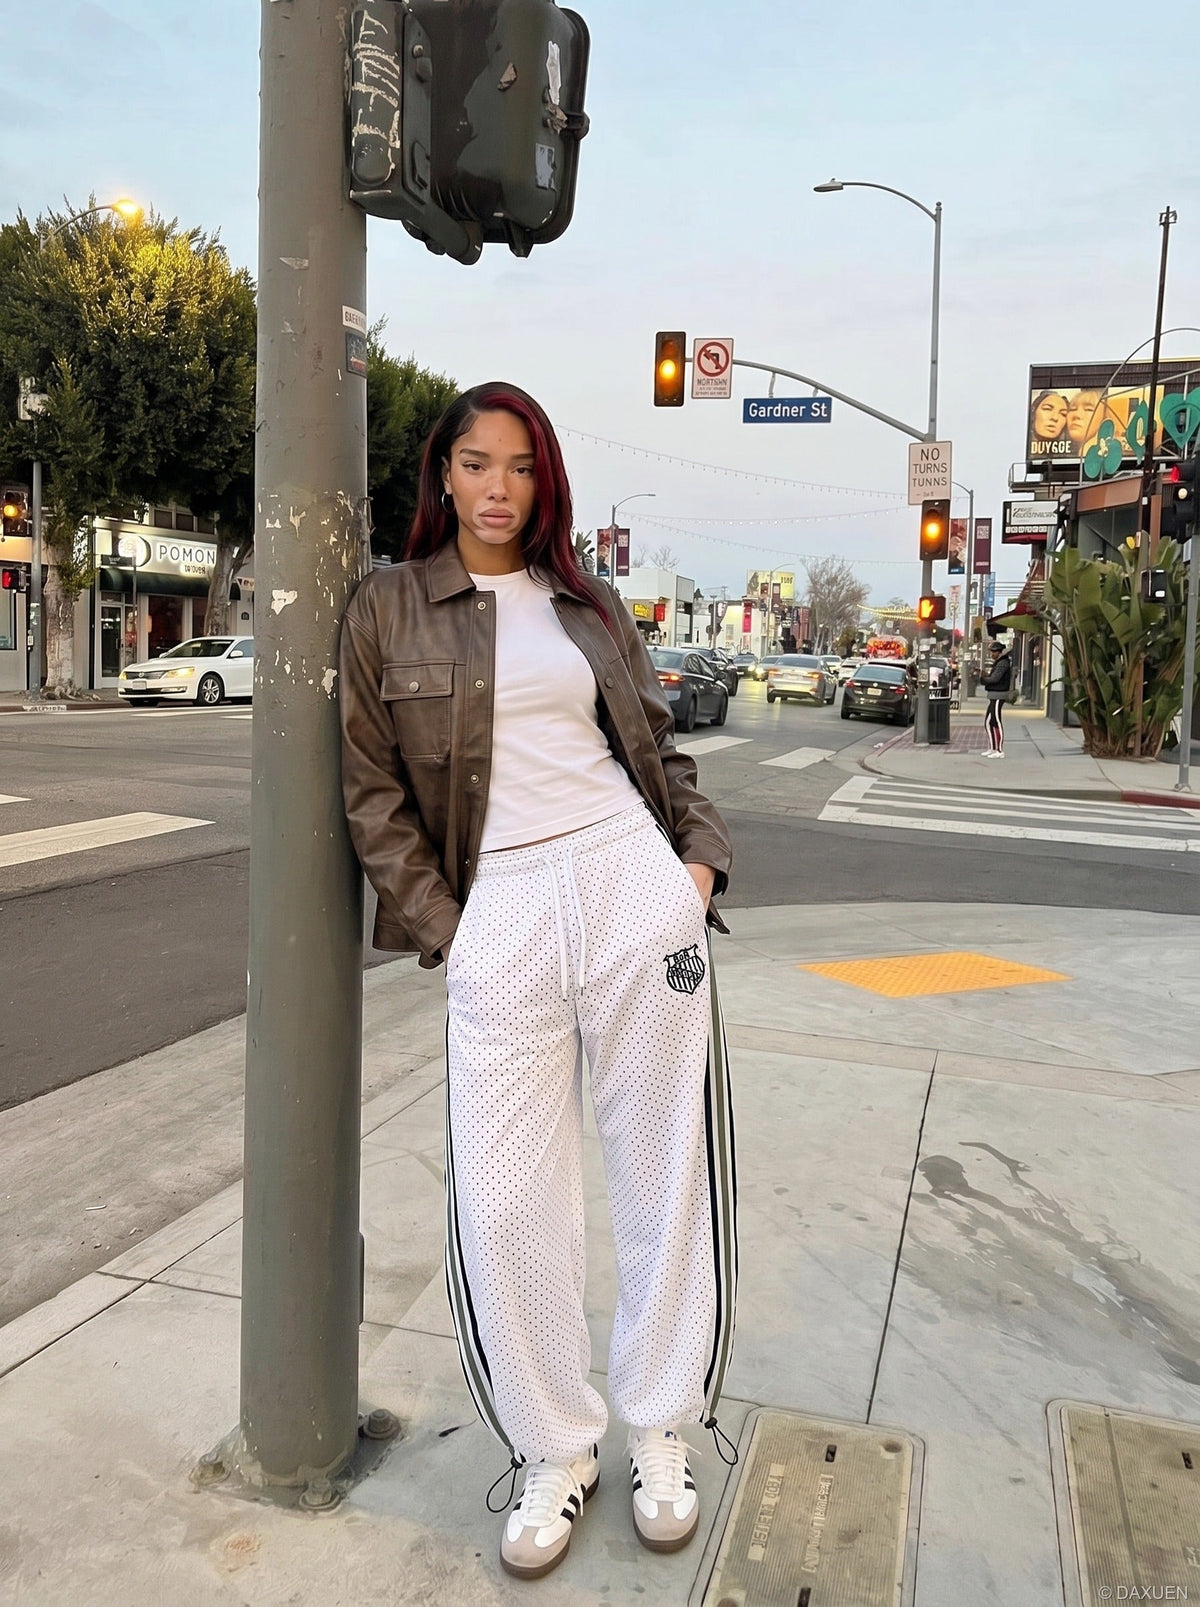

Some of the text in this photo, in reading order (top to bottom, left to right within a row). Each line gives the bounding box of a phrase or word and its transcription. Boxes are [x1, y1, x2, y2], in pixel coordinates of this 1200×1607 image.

[749, 402, 828, 417] Gardner St
[920, 447, 940, 461] NO
[912, 462, 948, 474] TURNS
[912, 476, 948, 487] TUNNS
